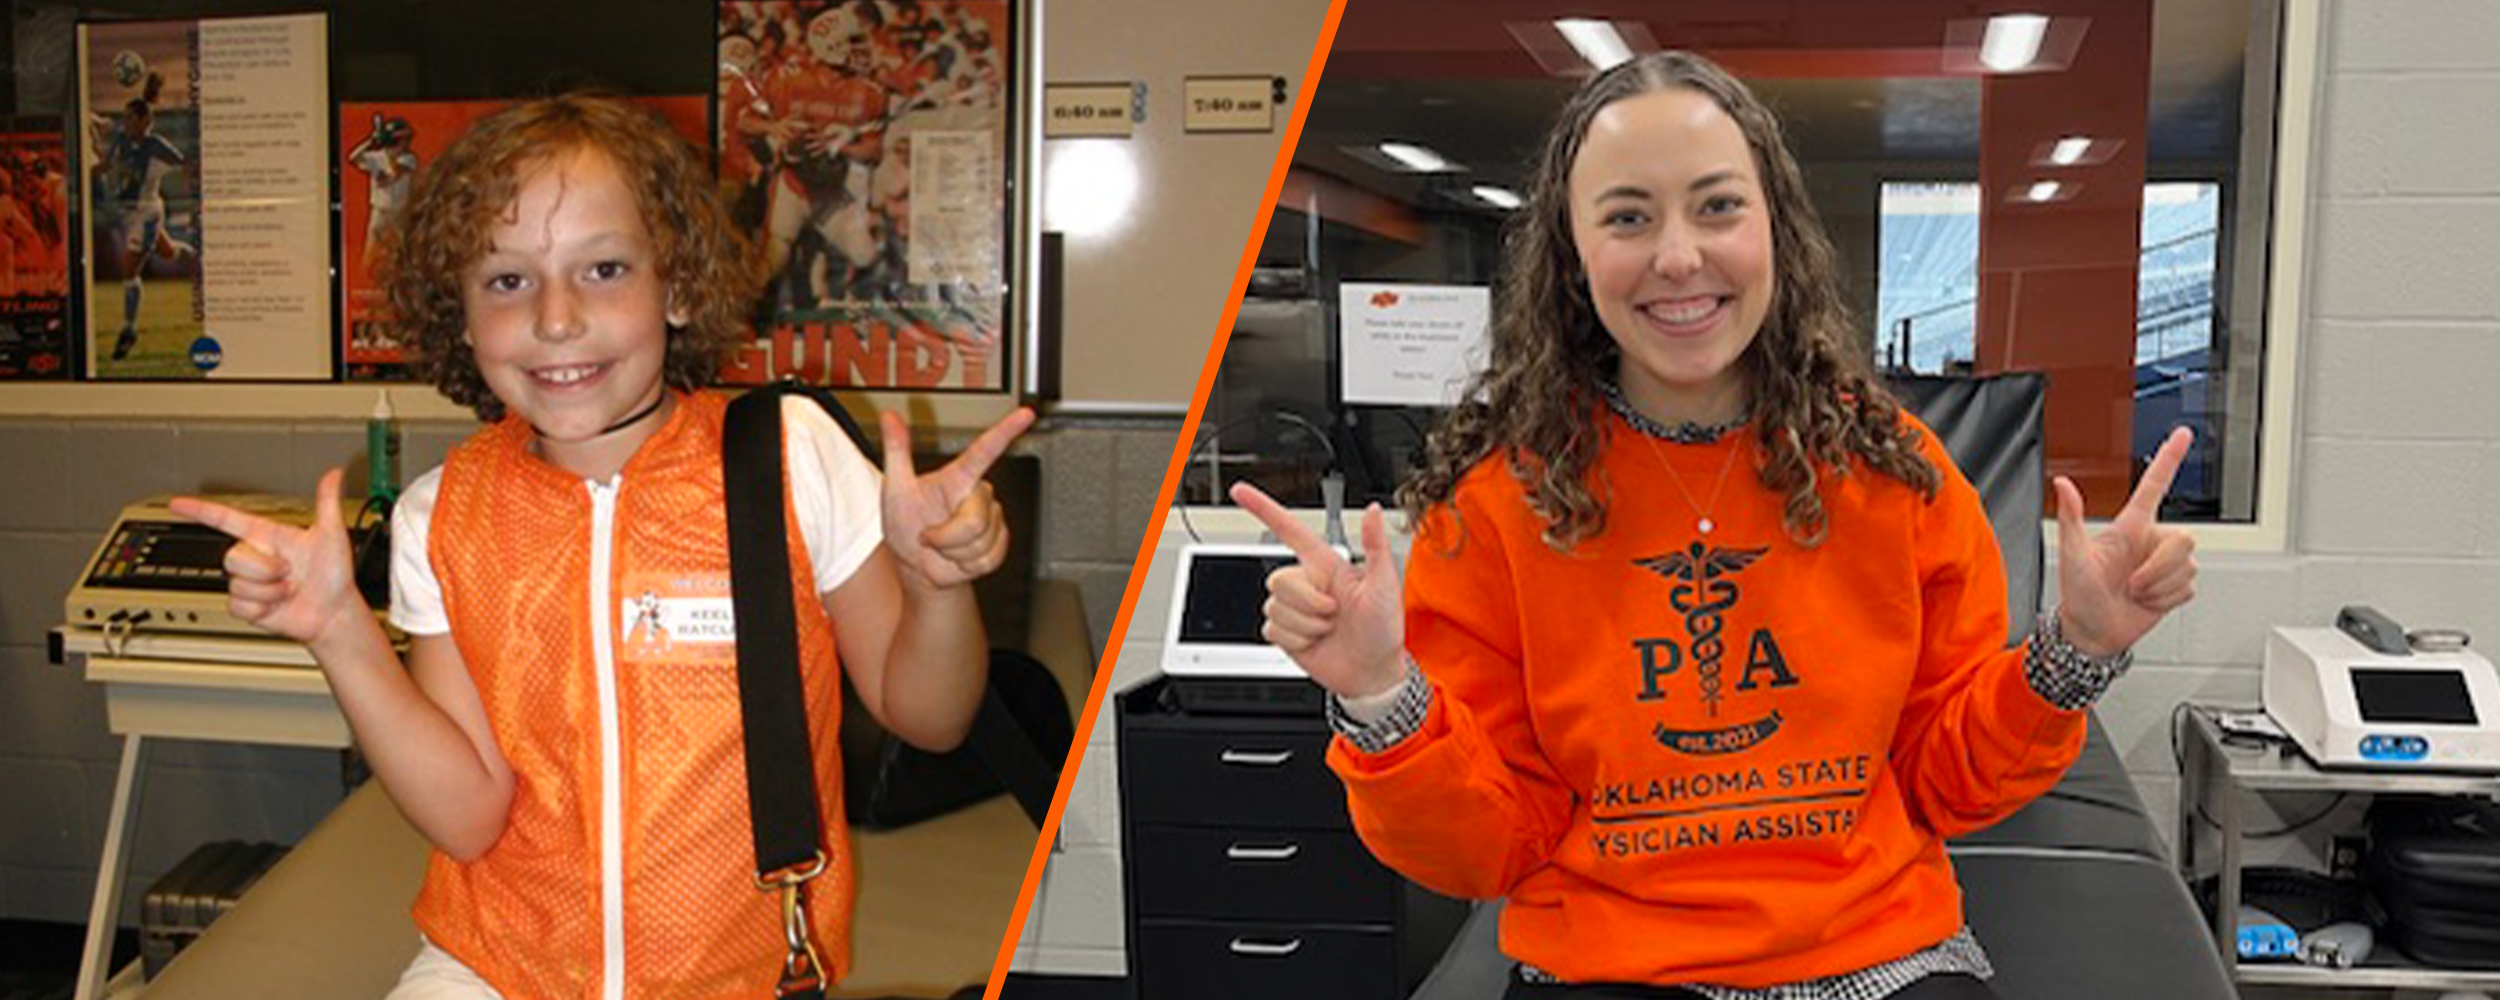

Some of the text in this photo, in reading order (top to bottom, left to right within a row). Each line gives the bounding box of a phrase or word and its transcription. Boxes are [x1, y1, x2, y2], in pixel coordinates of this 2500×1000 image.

[1098, 108, 1123, 118] am
[1194, 98, 1263, 113] 7:40 am
[717, 319, 994, 387] GUNDY
[1632, 627, 1799, 700] P A
[1777, 753, 1870, 789] STATE
